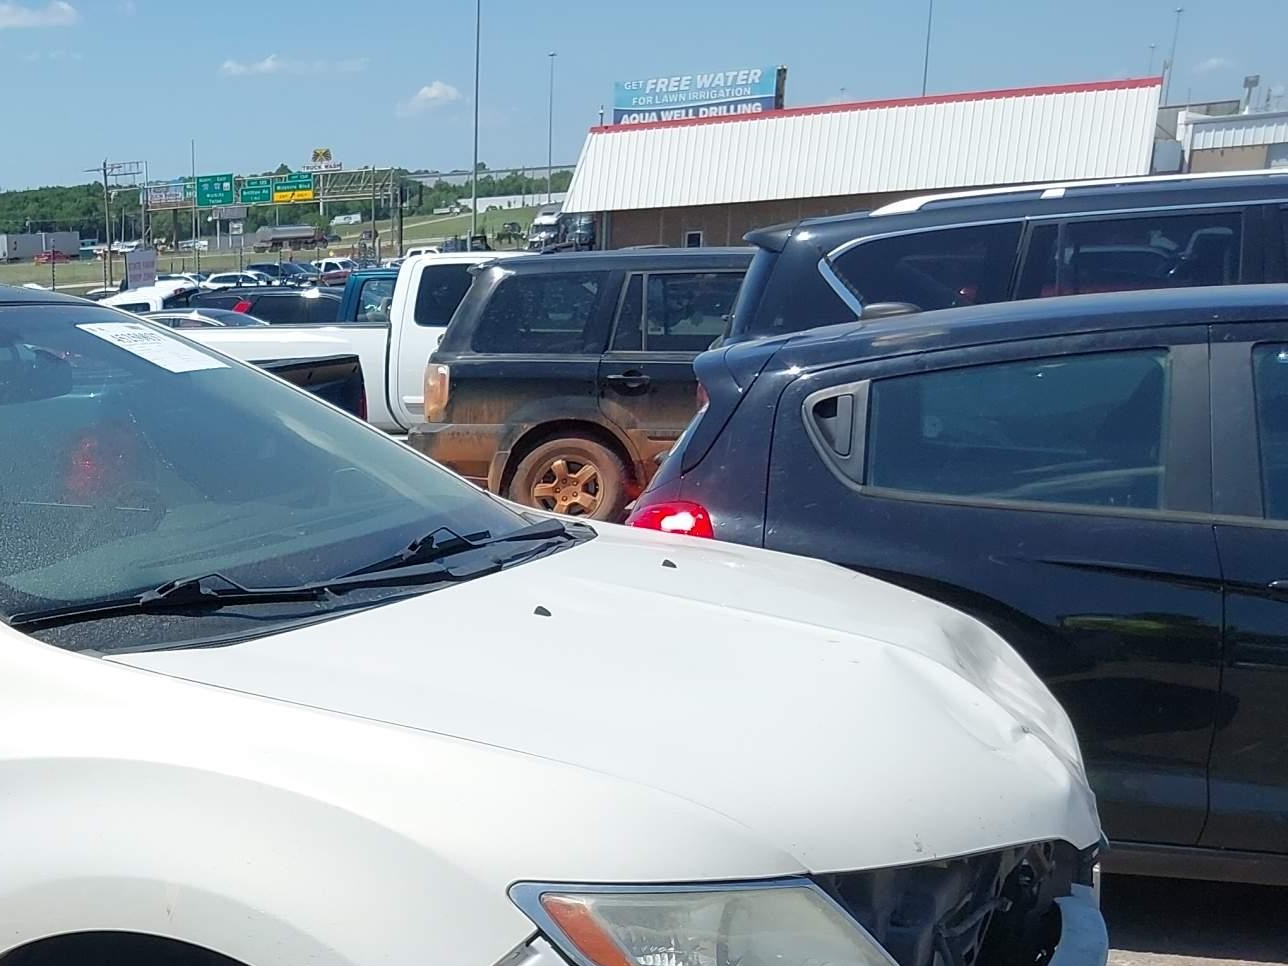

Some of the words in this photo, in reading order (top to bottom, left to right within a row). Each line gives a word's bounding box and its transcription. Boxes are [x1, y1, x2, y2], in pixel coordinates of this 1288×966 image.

[624, 80, 643, 90] GET
[645, 75, 692, 93] FREE
[695, 68, 762, 89] WATER
[632, 96, 654, 106] FOR
[654, 92, 687, 105] LAWN
[688, 87, 751, 101] IRRIGATION
[620, 111, 659, 125] AQUA
[661, 107, 696, 121] WELL
[699, 103, 762, 118] DRILLING
